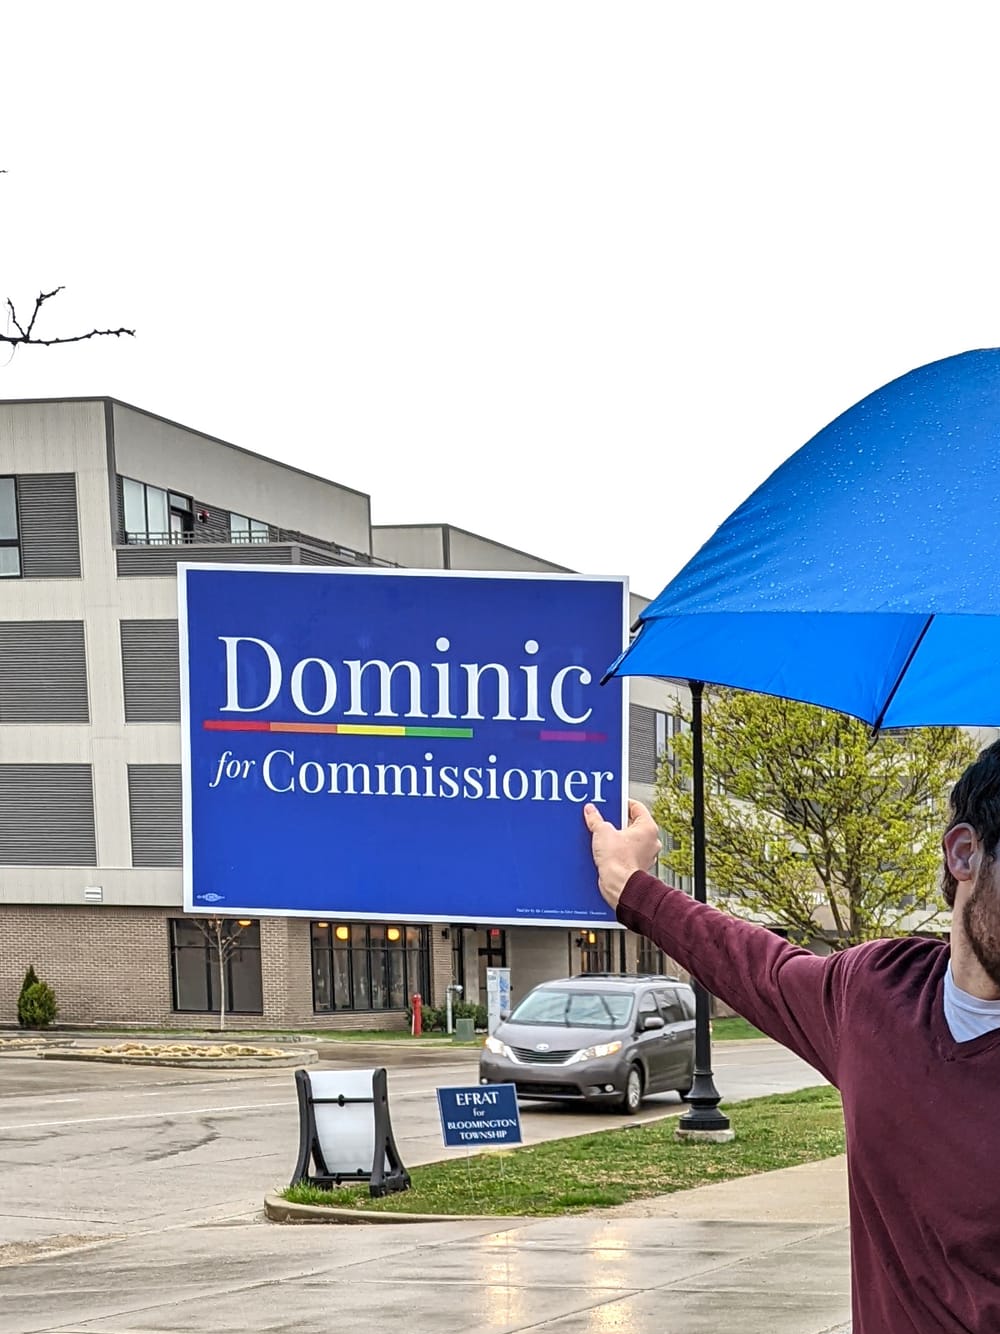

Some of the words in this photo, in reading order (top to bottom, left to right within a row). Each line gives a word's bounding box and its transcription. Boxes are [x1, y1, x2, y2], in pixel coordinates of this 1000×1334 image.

[218, 636, 593, 724] Dominic
[208, 750, 256, 788] for
[262, 749, 614, 803] Commissioner
[455, 1091, 499, 1106] EFRAT
[472, 1107, 485, 1117] for
[447, 1119, 517, 1130] BLOOMINGTON
[459, 1130, 508, 1140] TOWNSHIP
